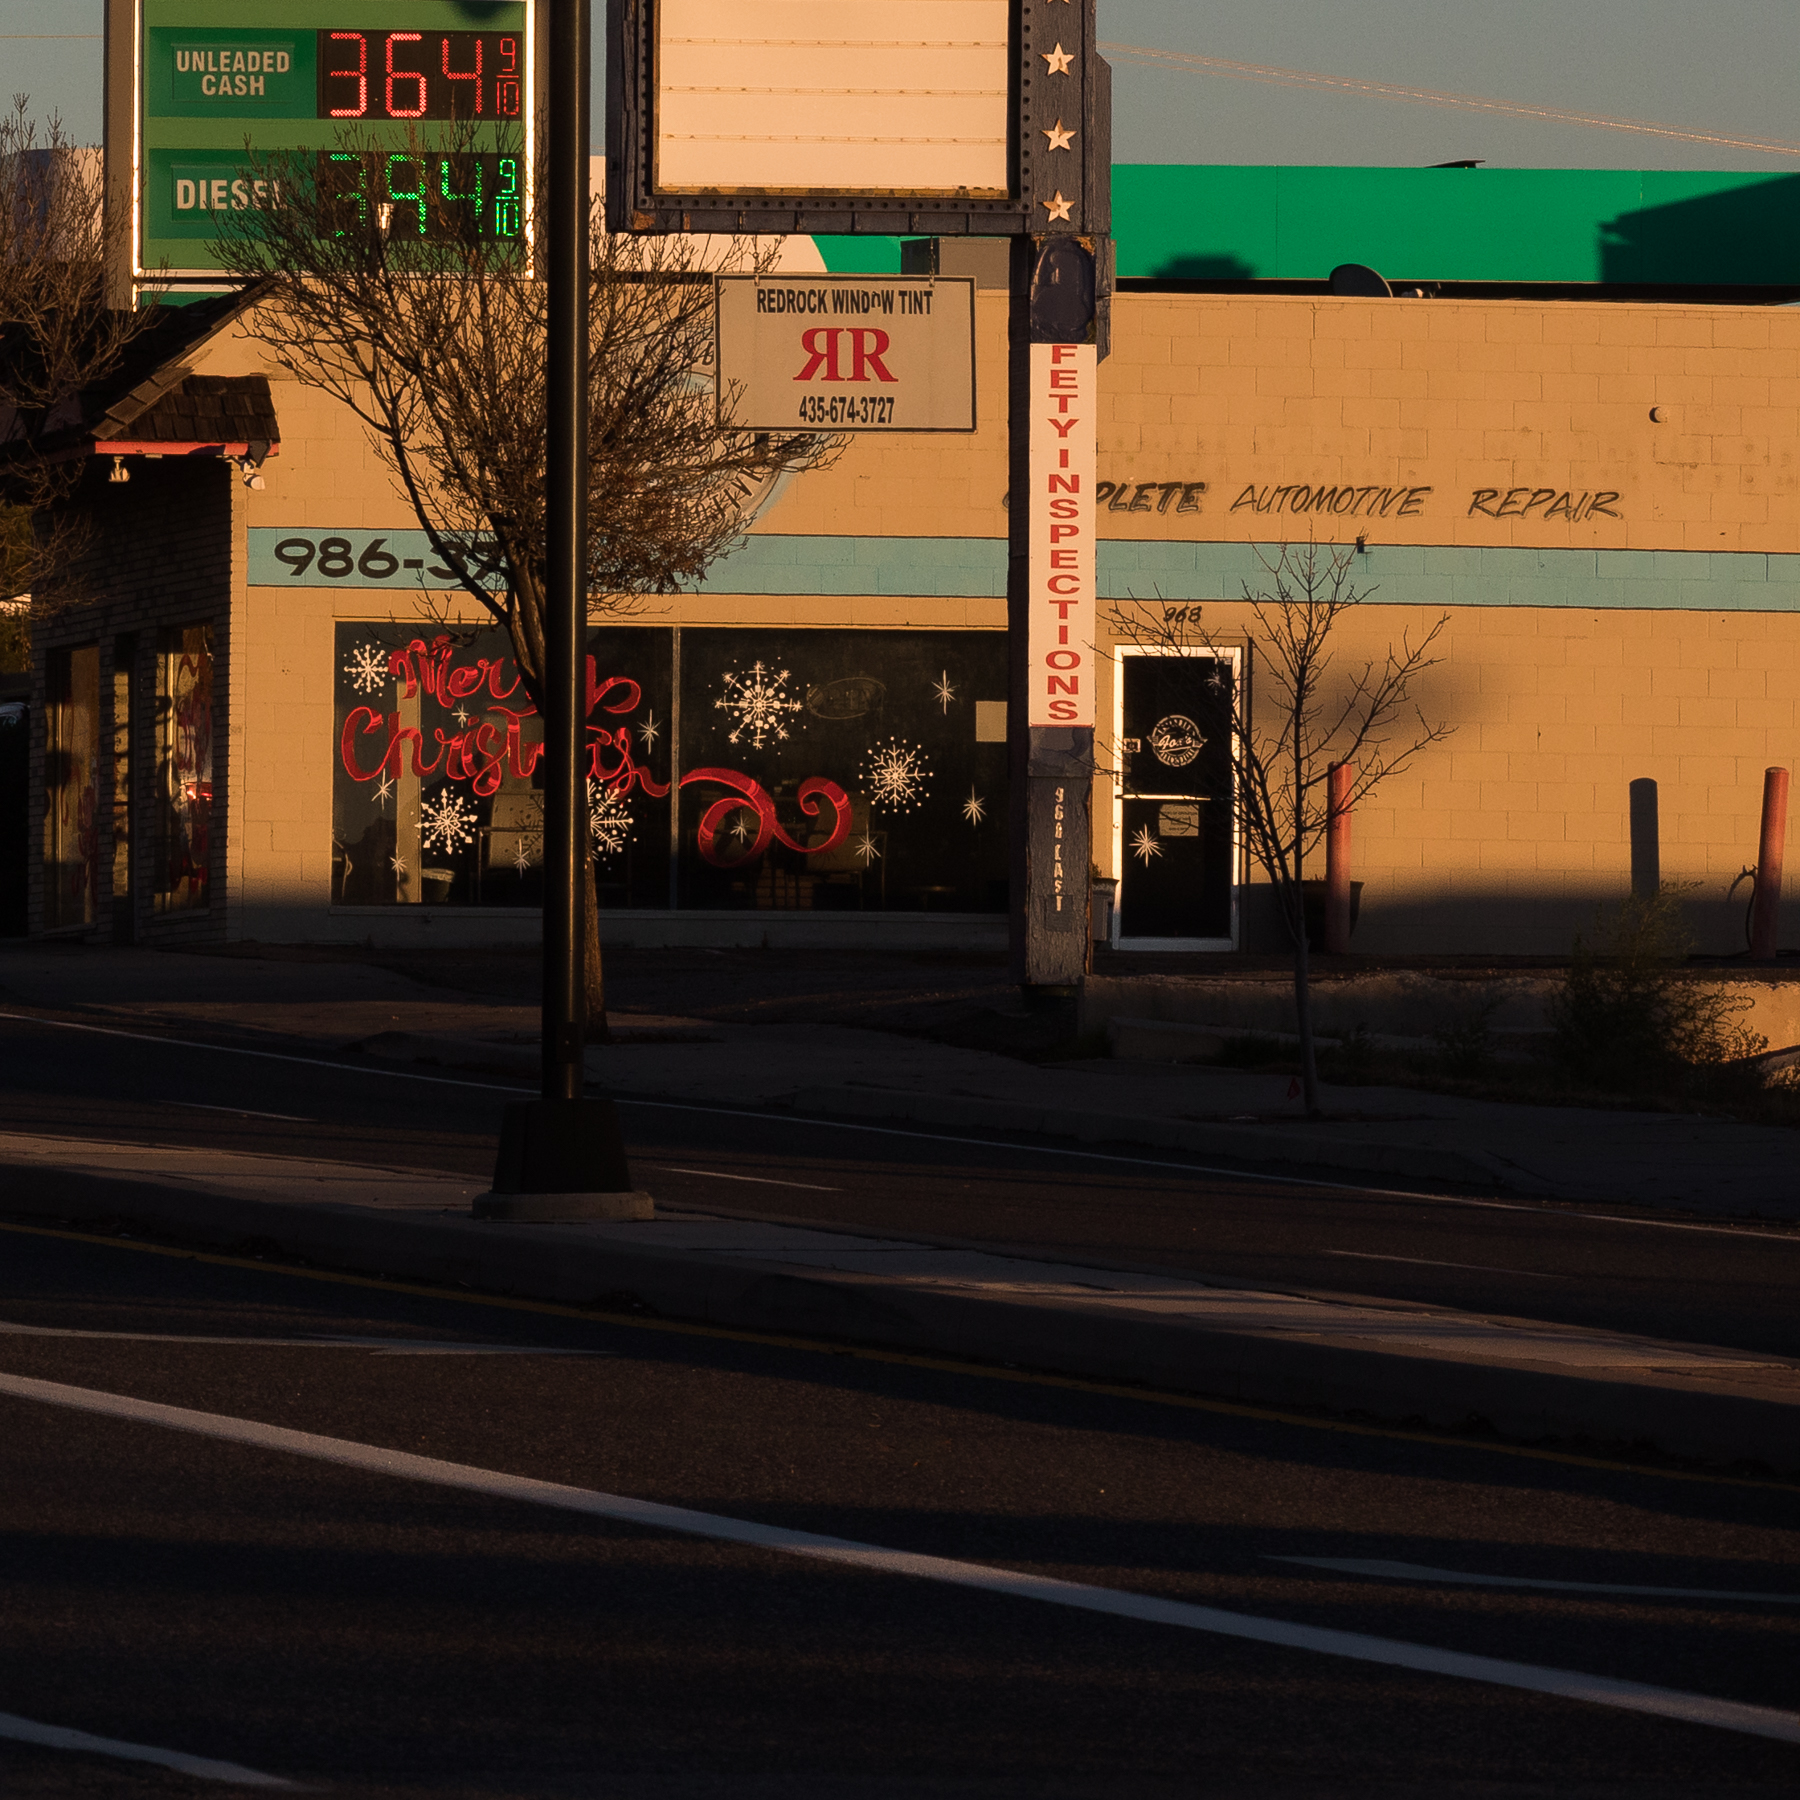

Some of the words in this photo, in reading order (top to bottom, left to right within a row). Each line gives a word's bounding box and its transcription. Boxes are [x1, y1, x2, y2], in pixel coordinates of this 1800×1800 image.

[175, 50, 291, 74] UNLEADED
[200, 74, 266, 97] CASH
[756, 288, 829, 315] REDROCK
[898, 290, 934, 316] TINT
[799, 395, 896, 425] 435-674-3727
[1230, 484, 1432, 518] AUTOMOTIVE
[1468, 486, 1624, 521] REPAIR
[1045, 448, 1082, 722] INSPECTIONS
[1162, 605, 1202, 623] 968
[1054, 844, 1065, 912] EAST
